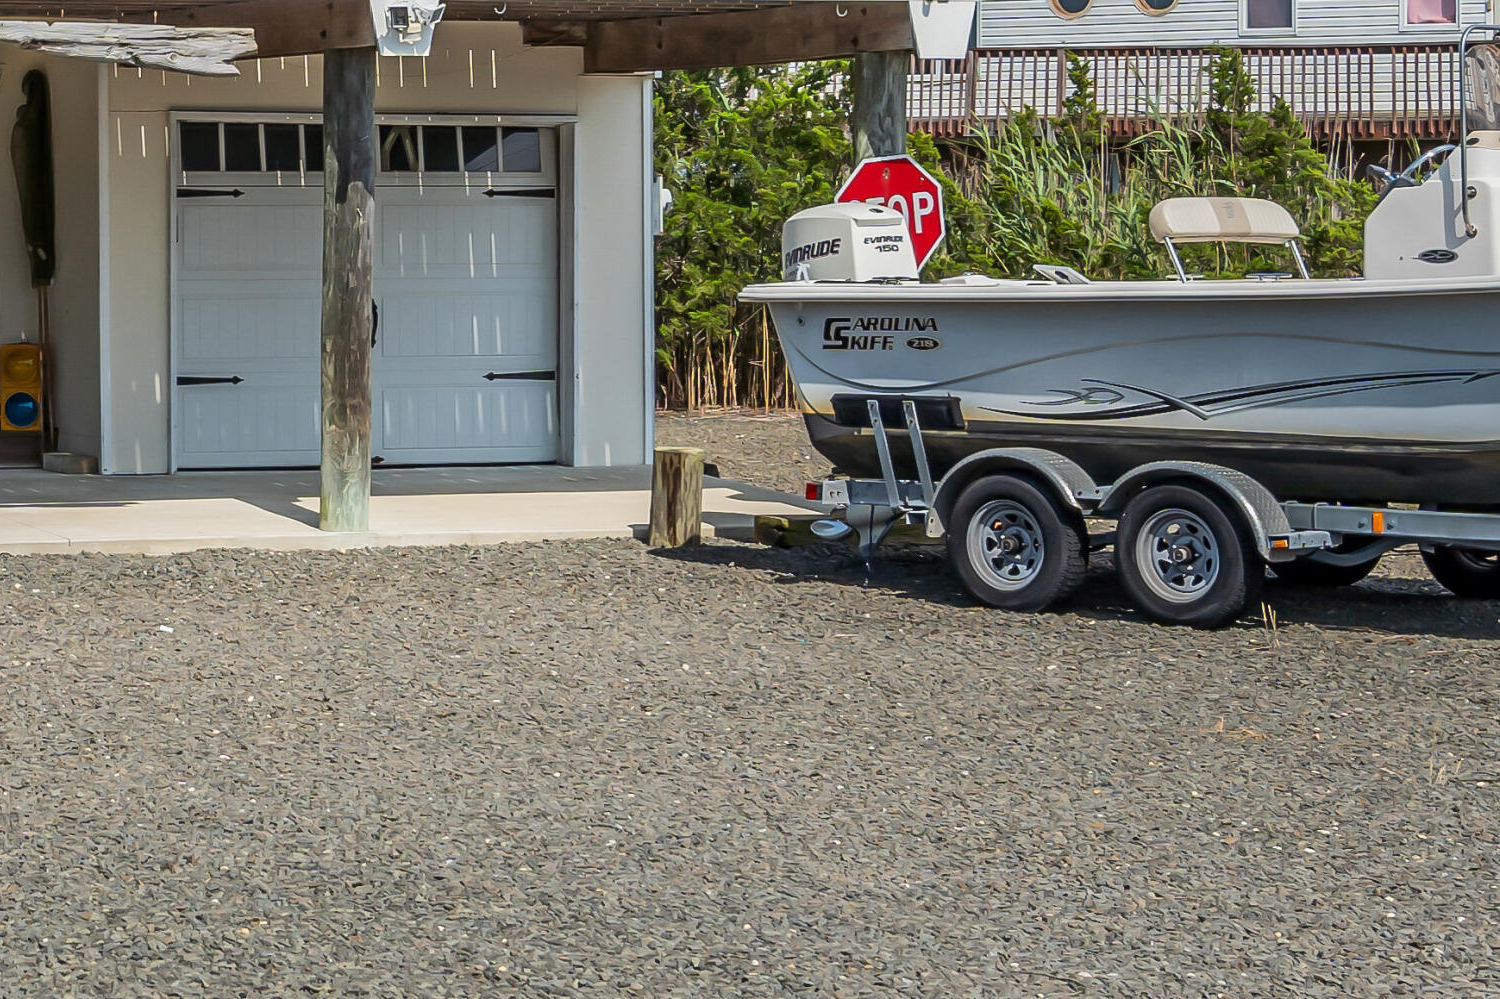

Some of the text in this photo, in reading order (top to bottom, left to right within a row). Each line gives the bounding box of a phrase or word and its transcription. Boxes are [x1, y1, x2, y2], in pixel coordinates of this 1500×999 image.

[863, 235, 903, 244] EVINRUDE
[785, 238, 842, 270] EVINRUDE
[874, 244, 899, 252] 150
[823, 317, 938, 339] CAROLINA
[822, 327, 894, 350] SKIFF
[910, 339, 935, 348] 218
